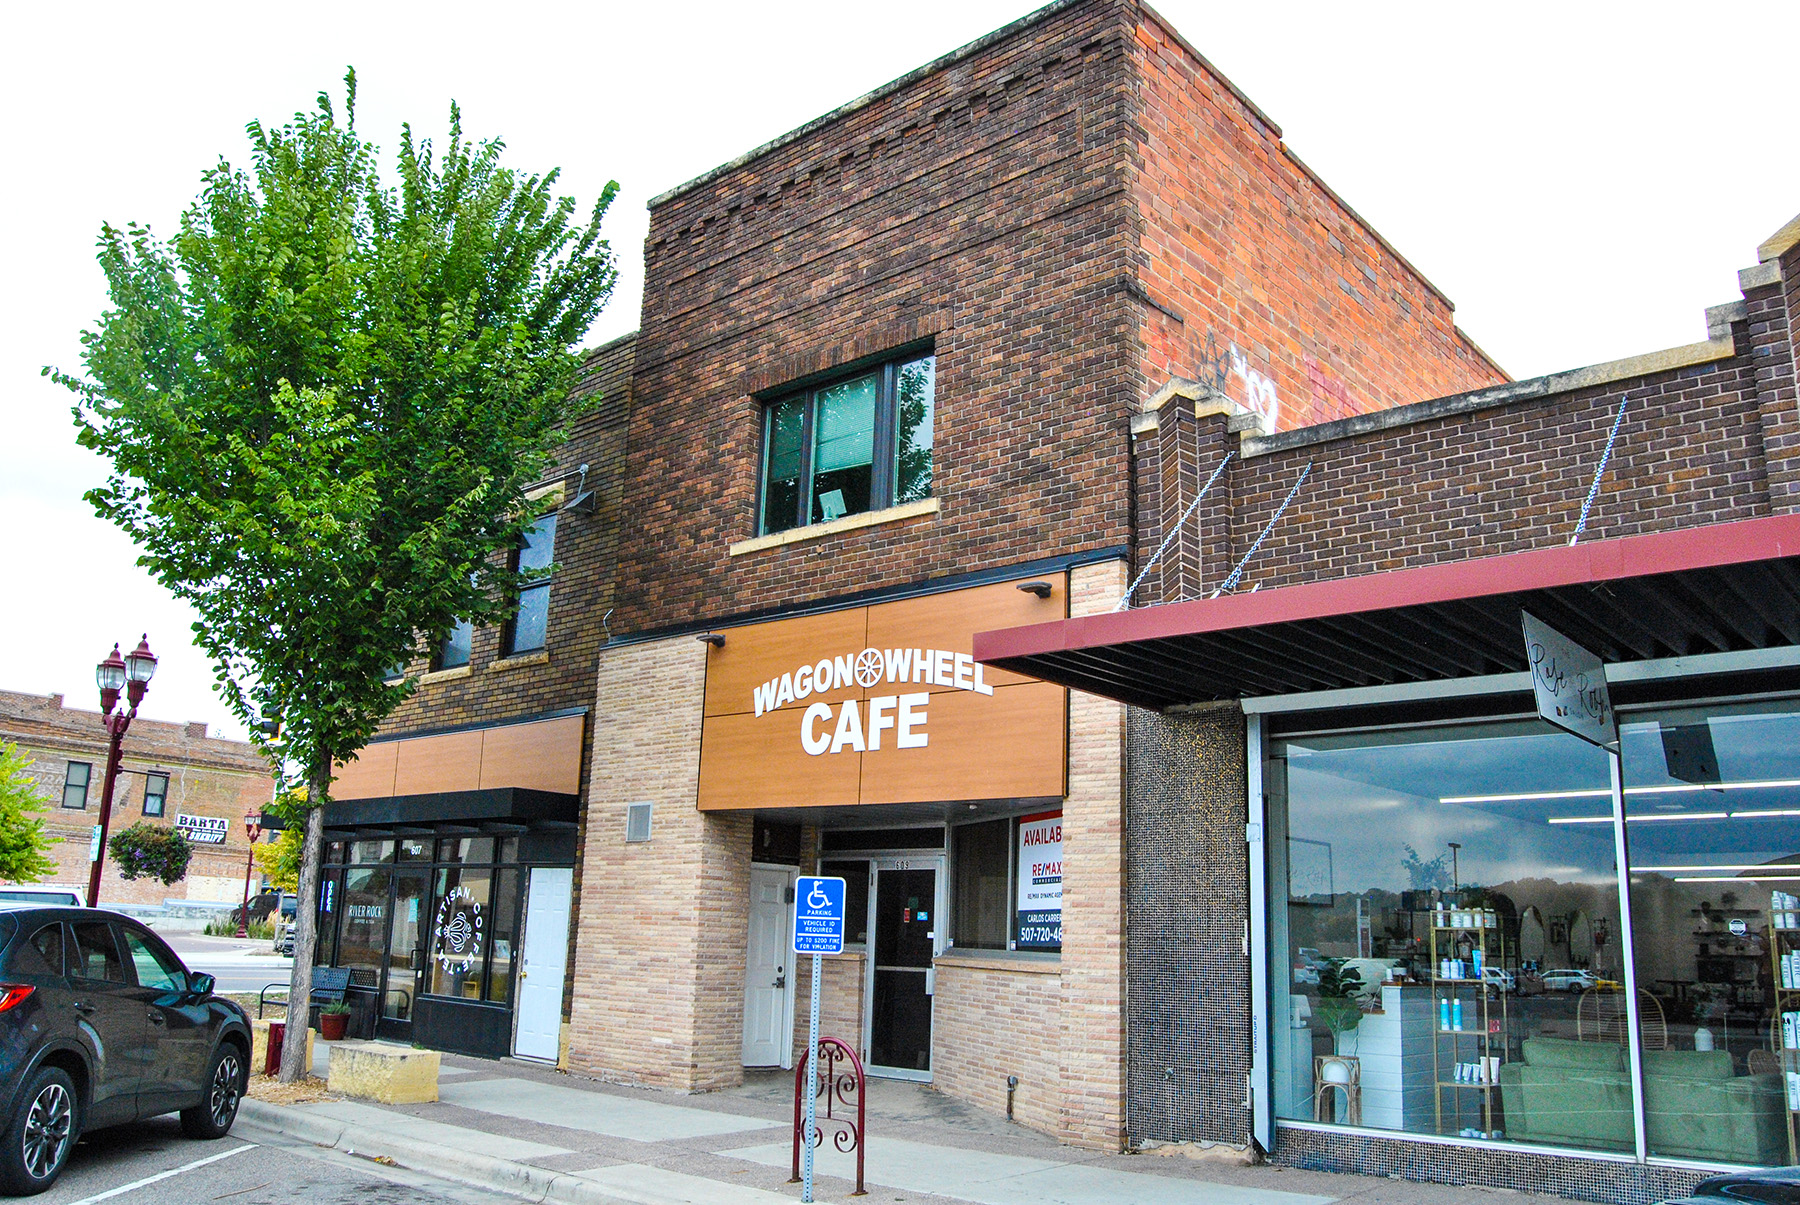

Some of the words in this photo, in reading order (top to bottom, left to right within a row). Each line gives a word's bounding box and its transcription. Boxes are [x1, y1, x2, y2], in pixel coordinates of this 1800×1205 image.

[753, 653, 854, 718] WAGON
[884, 648, 994, 697] WHEEL
[800, 692, 930, 756] CAFE
[179, 815, 226, 830] BARTA
[1023, 825, 1062, 847] AVAILAB
[411, 845, 422, 855] 607
[895, 861, 910, 870] 609
[1032, 861, 1062, 876] RE/MAX
[348, 904, 365, 917] RIVER
[366, 905, 382, 918] ROCK
[434, 886, 470, 937] ARTISAN
[1027, 913, 1044, 922] CARLOS
[461, 902, 483, 972] COFFEE
[437, 948, 454, 975] TEA
